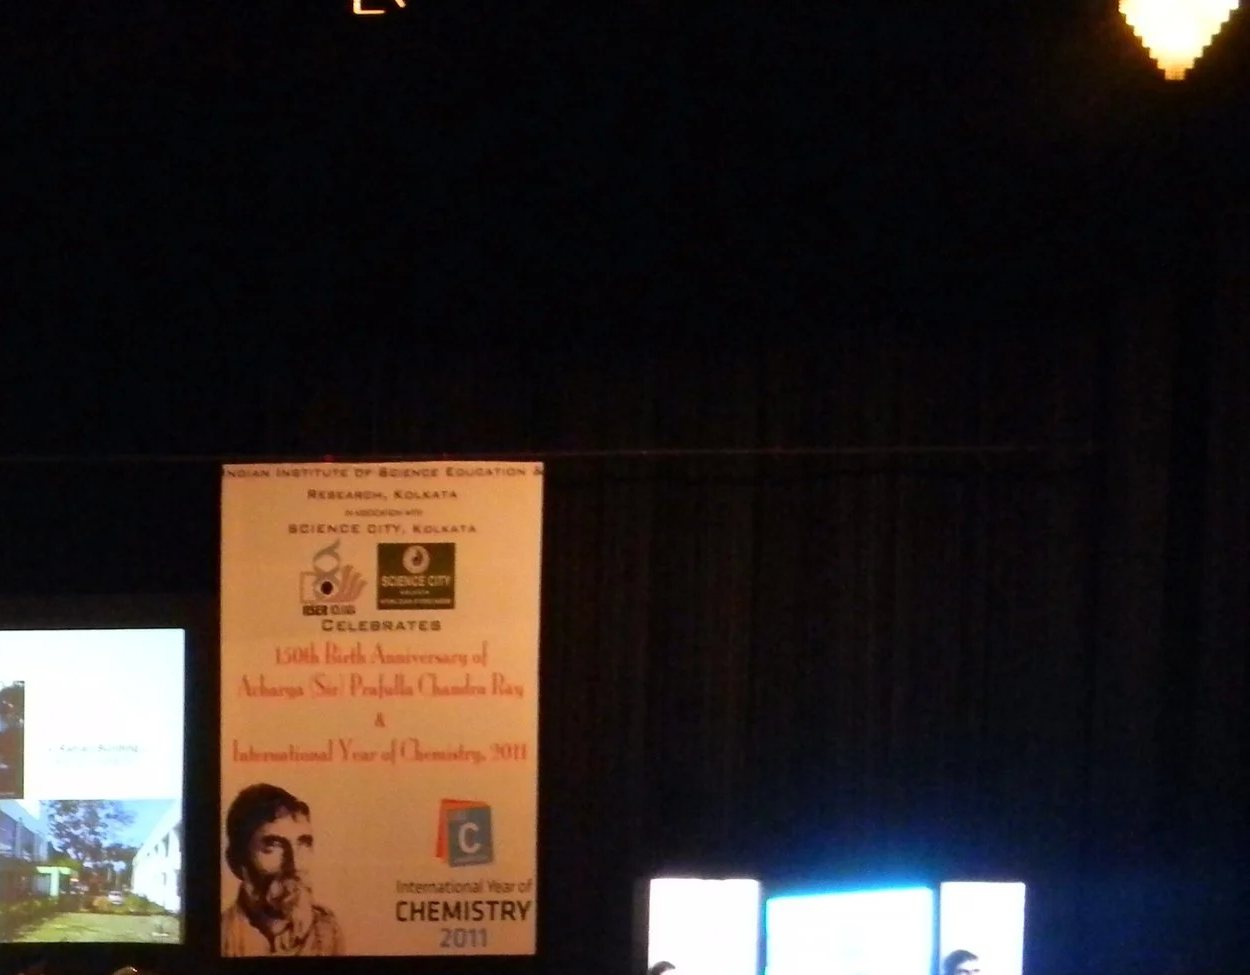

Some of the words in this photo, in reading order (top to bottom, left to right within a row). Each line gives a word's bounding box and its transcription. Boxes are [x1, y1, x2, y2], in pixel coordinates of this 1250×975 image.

[288, 523, 360, 534] SCIENCE
[412, 523, 477, 533] KOLKATA
[381, 575, 426, 588] SCIENCE
[428, 575, 451, 587] CITY
[321, 619, 442, 632] CELEBRATES
[275, 641, 320, 665] 150th
[326, 640, 367, 665] Birth
[370, 642, 468, 667] Anniversary
[473, 640, 488, 667] of
[237, 673, 305, 698] Acharya
[350, 672, 413, 699] Prafulla
[418, 672, 486, 697] Chandra
[492, 672, 525, 698] Ray
[374, 711, 386, 728] &
[233, 738, 333, 762] International
[337, 738, 378, 761] Year
[380, 737, 397, 765] of
[489, 743, 527, 761] 2011
[458, 821, 481, 854] C
[395, 878, 484, 894] International
[486, 879, 517, 894] Year
[518, 877, 533, 894] of
[395, 899, 532, 922] CHEMISTRY
[439, 927, 488, 948] 2011
